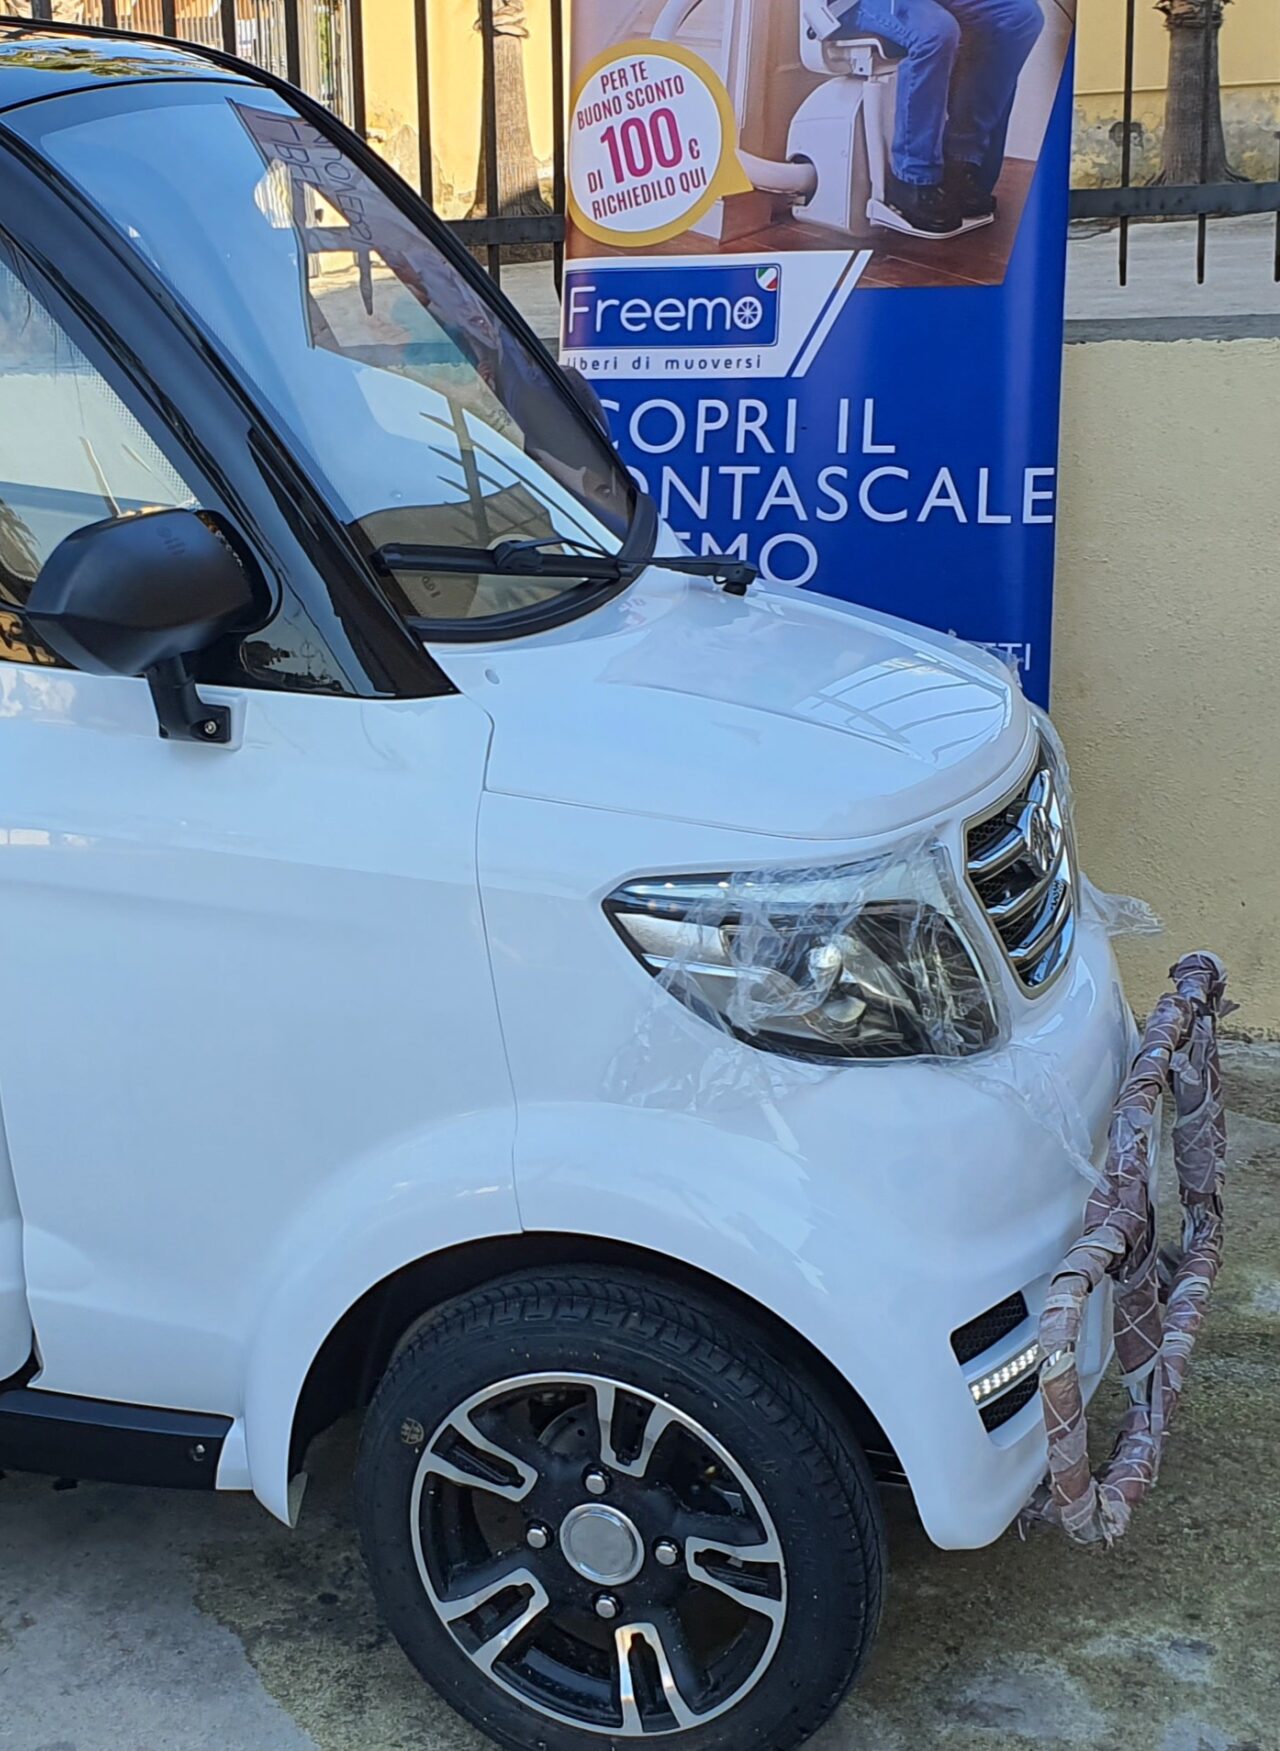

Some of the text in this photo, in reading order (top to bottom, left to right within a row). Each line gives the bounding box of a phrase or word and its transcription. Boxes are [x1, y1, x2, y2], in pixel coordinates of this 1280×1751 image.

[577, 75, 685, 130] BUONO SCONTO
[600, 61, 648, 94] PER TE
[587, 169, 604, 193] DI
[600, 108, 683, 184] 100
[592, 166, 707, 220] RICHIEDILO QUI
[568, 286, 763, 333] Freemo
[632, 356, 650, 370] di
[665, 355, 761, 370] muoversi
[837, 398, 896, 453] IL
[626, 465, 1055, 524] NTASCALE
